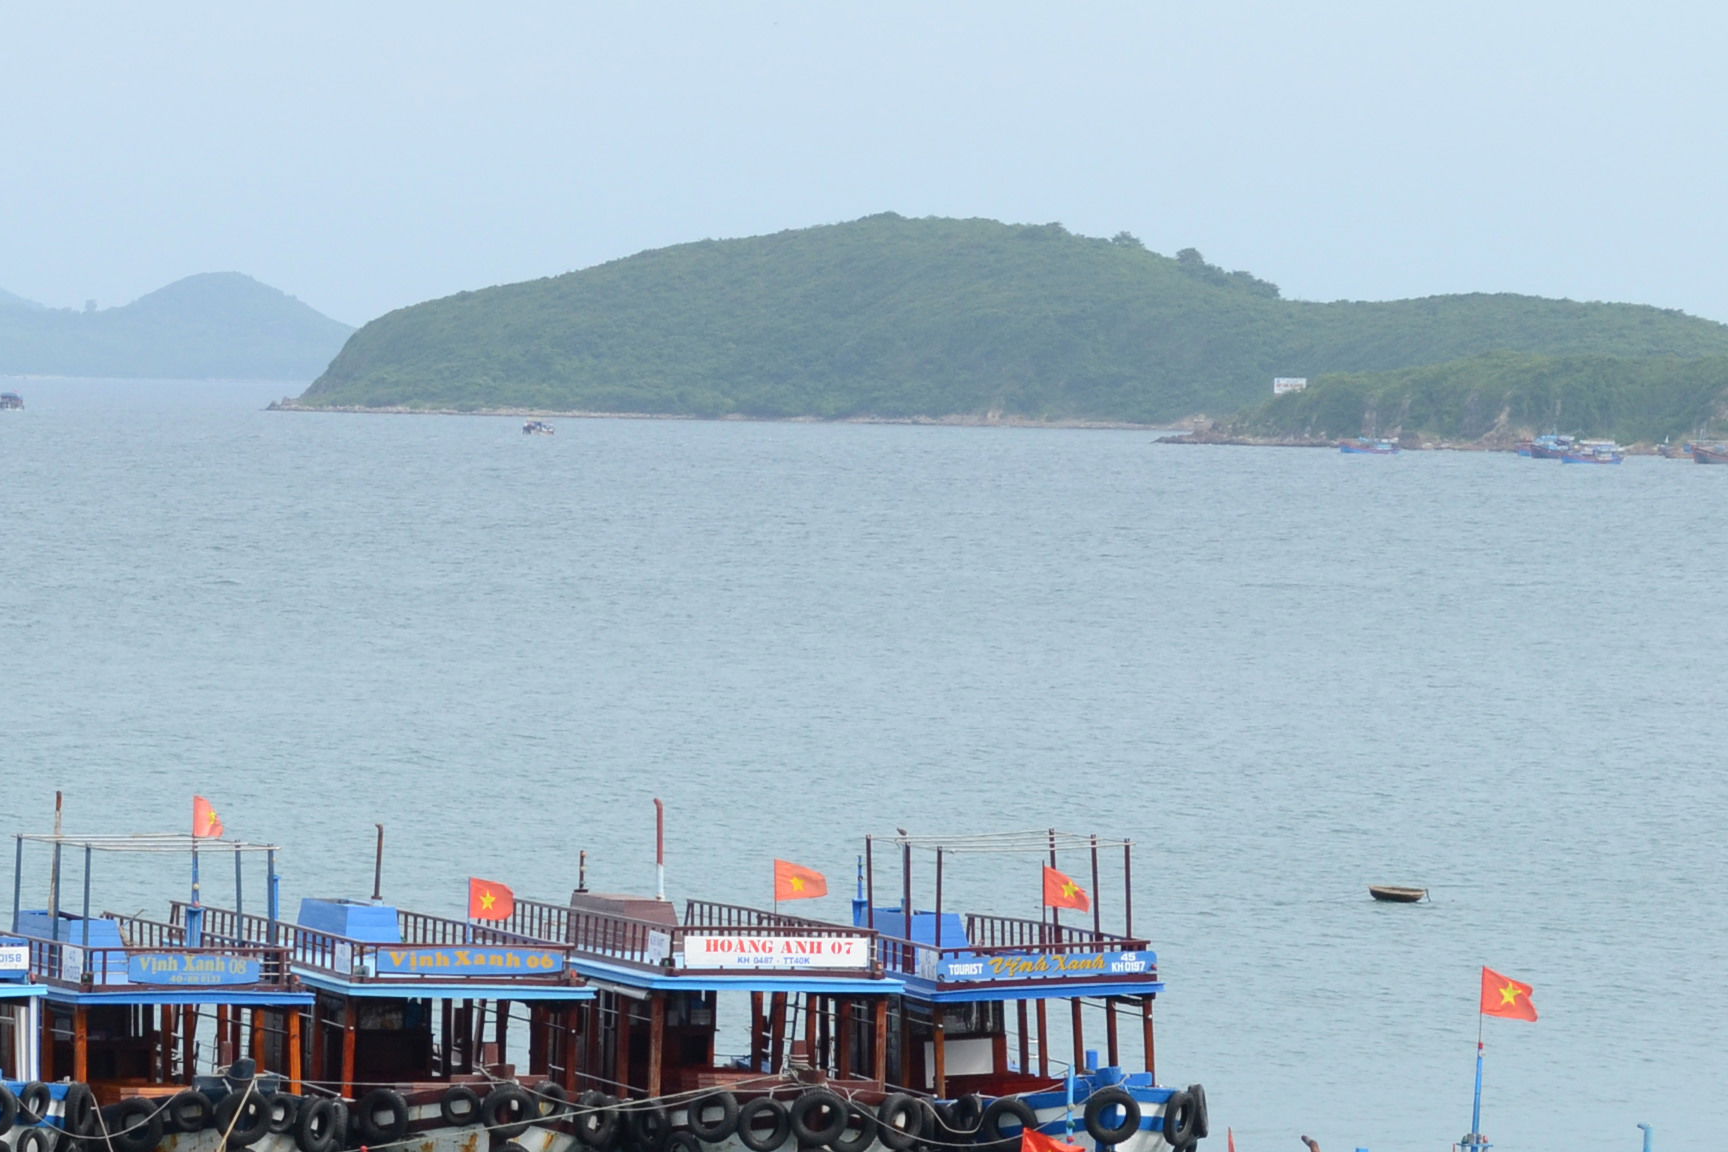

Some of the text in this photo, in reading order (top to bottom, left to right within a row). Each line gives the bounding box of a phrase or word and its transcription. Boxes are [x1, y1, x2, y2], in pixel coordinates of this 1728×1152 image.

[781, 940, 823, 955] ANH
[831, 941, 854, 955] 07
[1120, 952, 1136, 961] 45
[183, 954, 225, 972] Xanh
[229, 959, 247, 974] 08
[454, 951, 521, 969] Xanh
[527, 957, 554, 969] 06
[948, 963, 984, 976] TOURIST
[1052, 953, 1108, 972] Xanh
